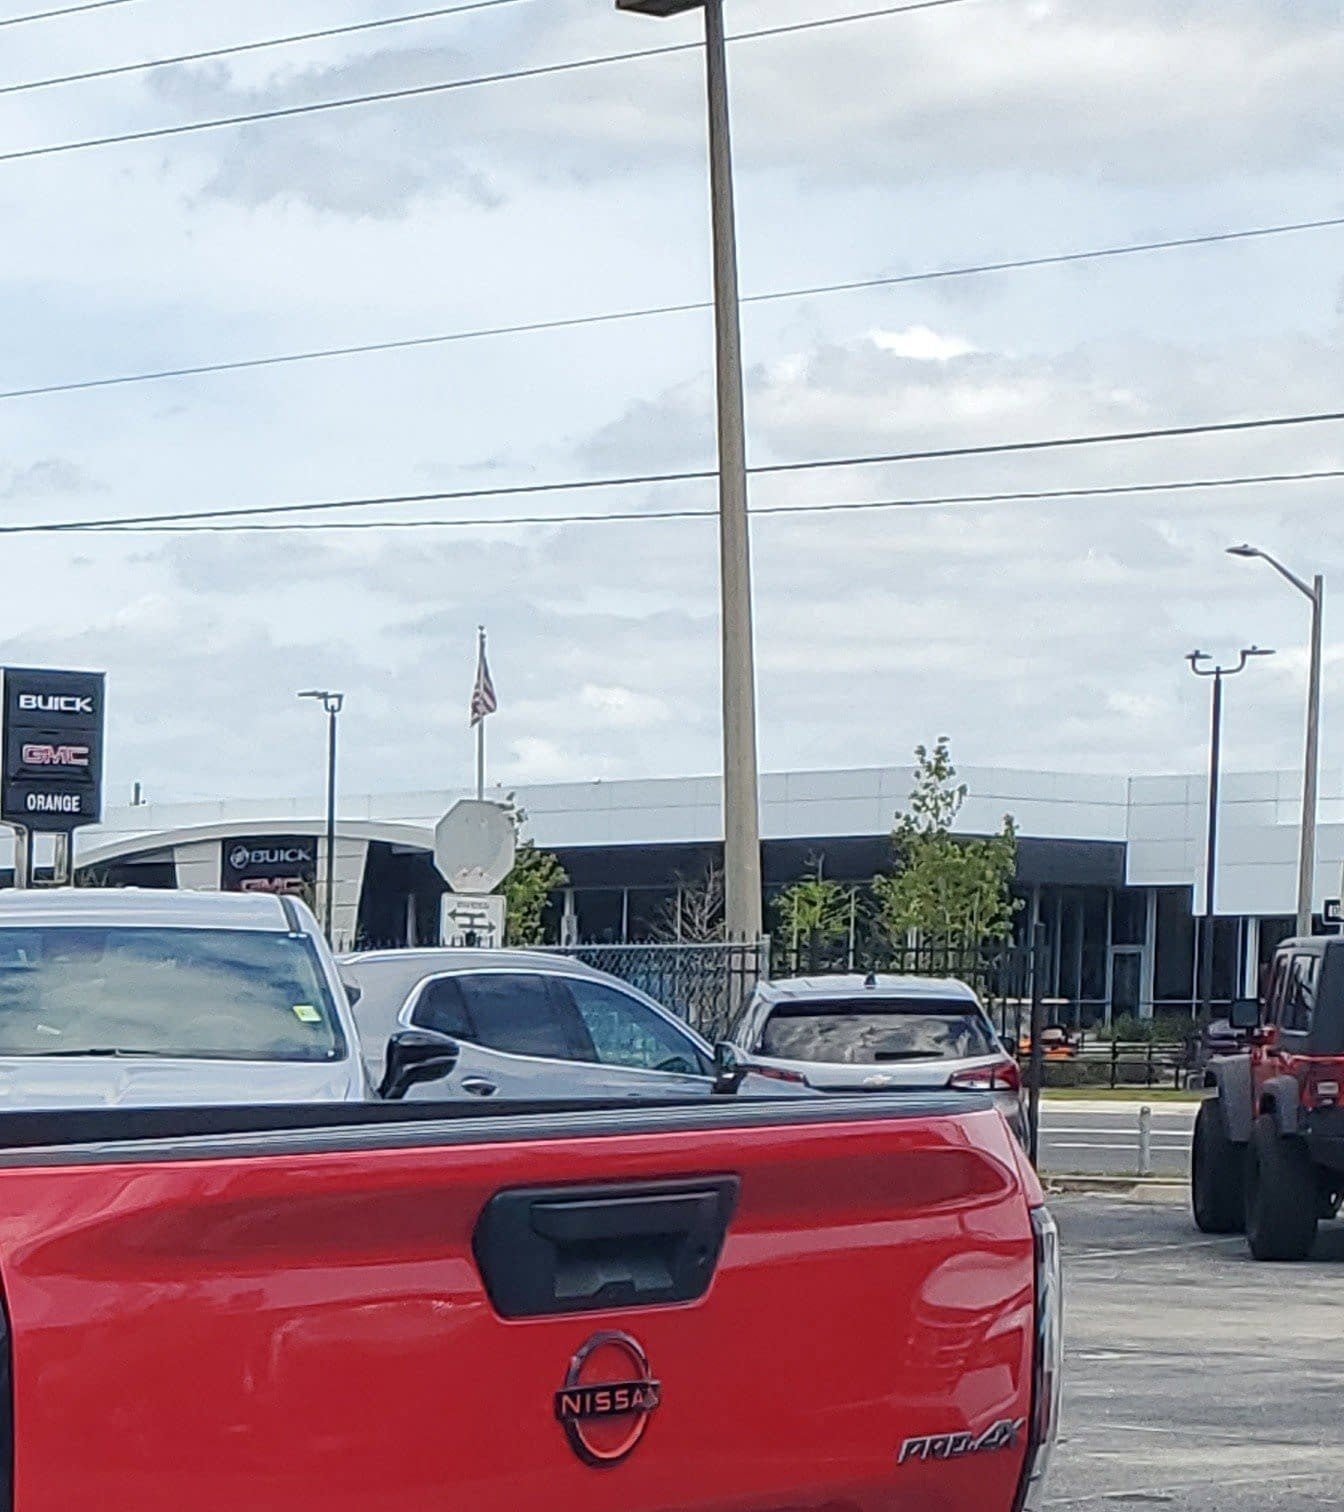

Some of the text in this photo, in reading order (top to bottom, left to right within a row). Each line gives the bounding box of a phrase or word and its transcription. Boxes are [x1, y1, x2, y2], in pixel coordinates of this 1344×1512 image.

[18, 694, 93, 712] BUICK
[22, 744, 89, 766] GMC
[27, 794, 81, 812] ORANGE
[250, 848, 312, 864] BUICK
